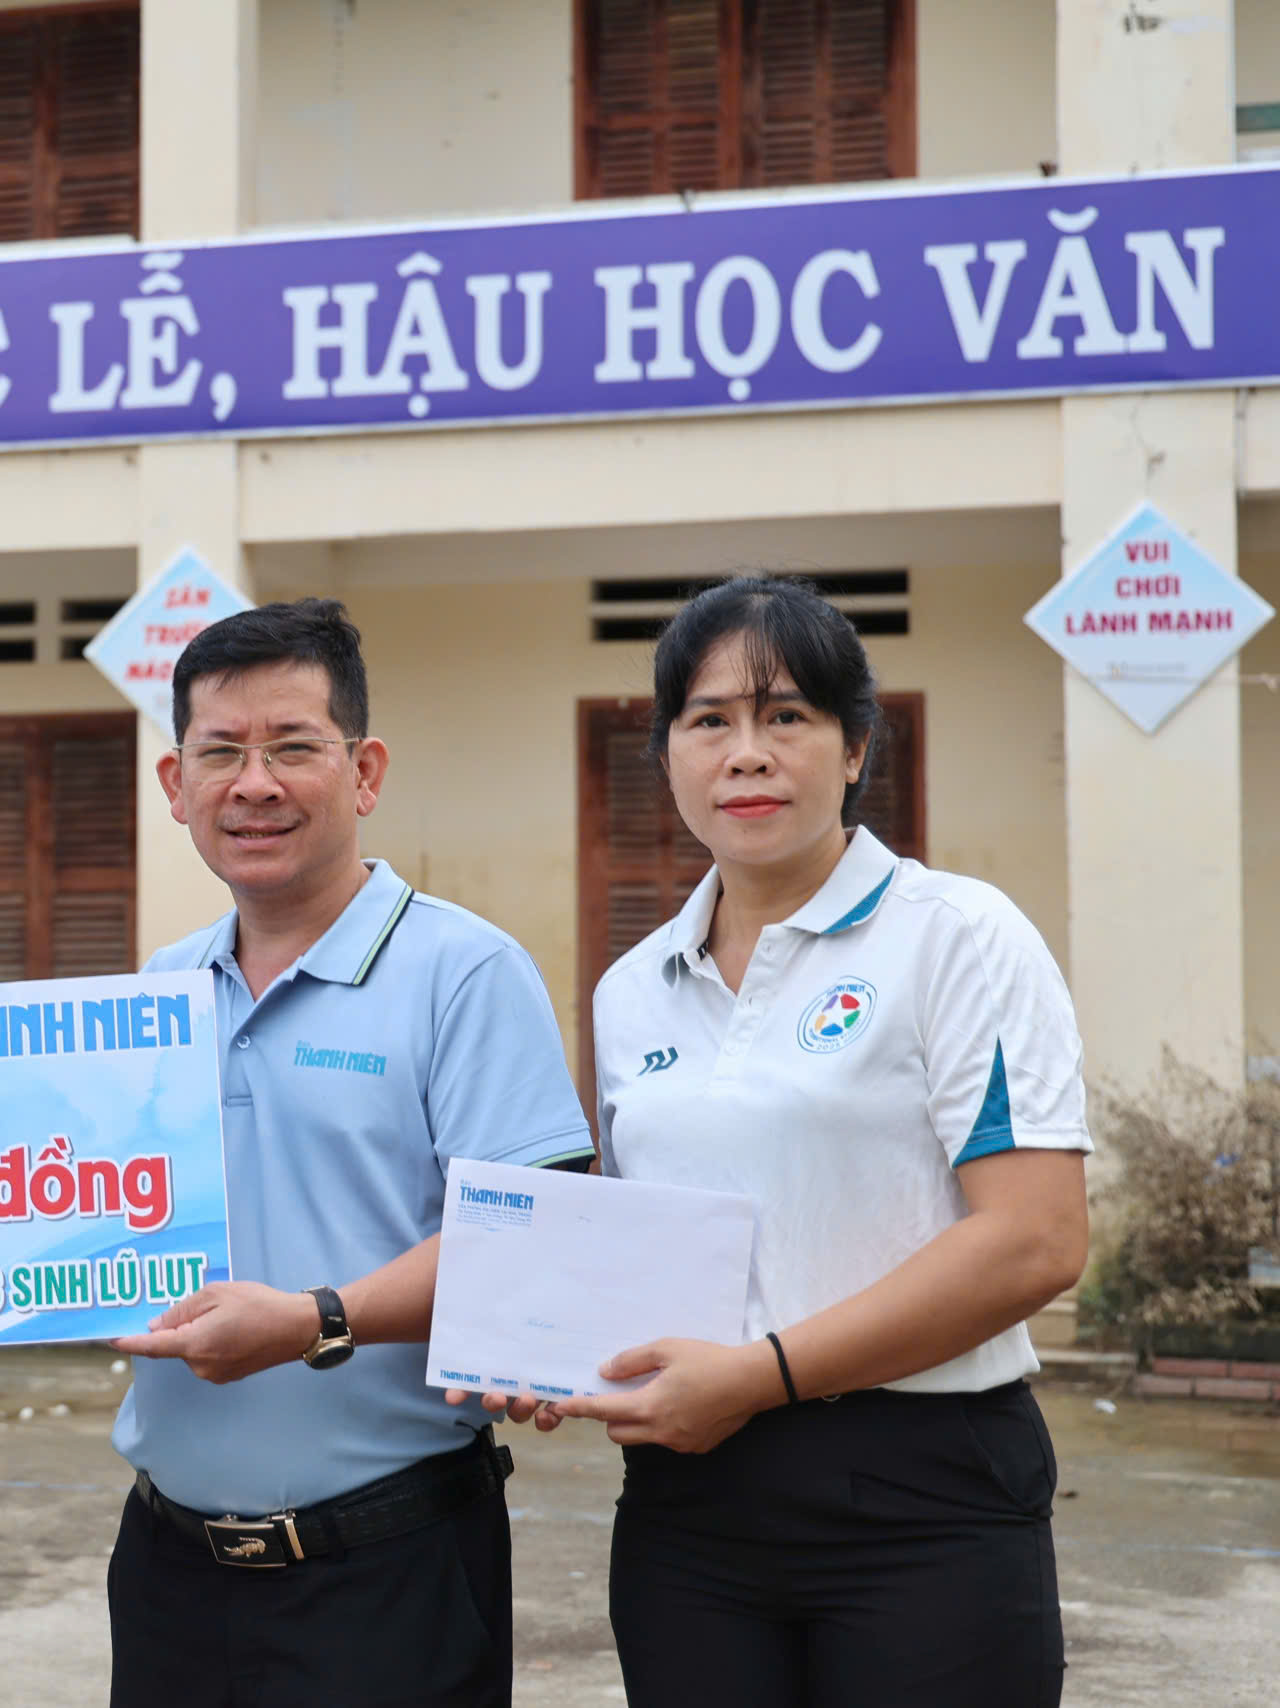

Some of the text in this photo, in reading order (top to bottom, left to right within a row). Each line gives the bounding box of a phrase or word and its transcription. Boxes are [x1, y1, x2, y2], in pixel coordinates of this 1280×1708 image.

[48, 251, 237, 421] LỄ,
[283, 251, 553, 417] HẬU
[593, 248, 882, 401] HỌC
[923, 205, 1226, 362] VĂN
[1124, 541, 1170, 563] VUI
[1114, 573, 1181, 598] CHƠI
[460, 1185, 503, 1206] THANH
[11, 1263, 90, 1307] SINH
[99, 1253, 137, 1301] LŨ
[148, 1256, 204, 1304] LỤT
